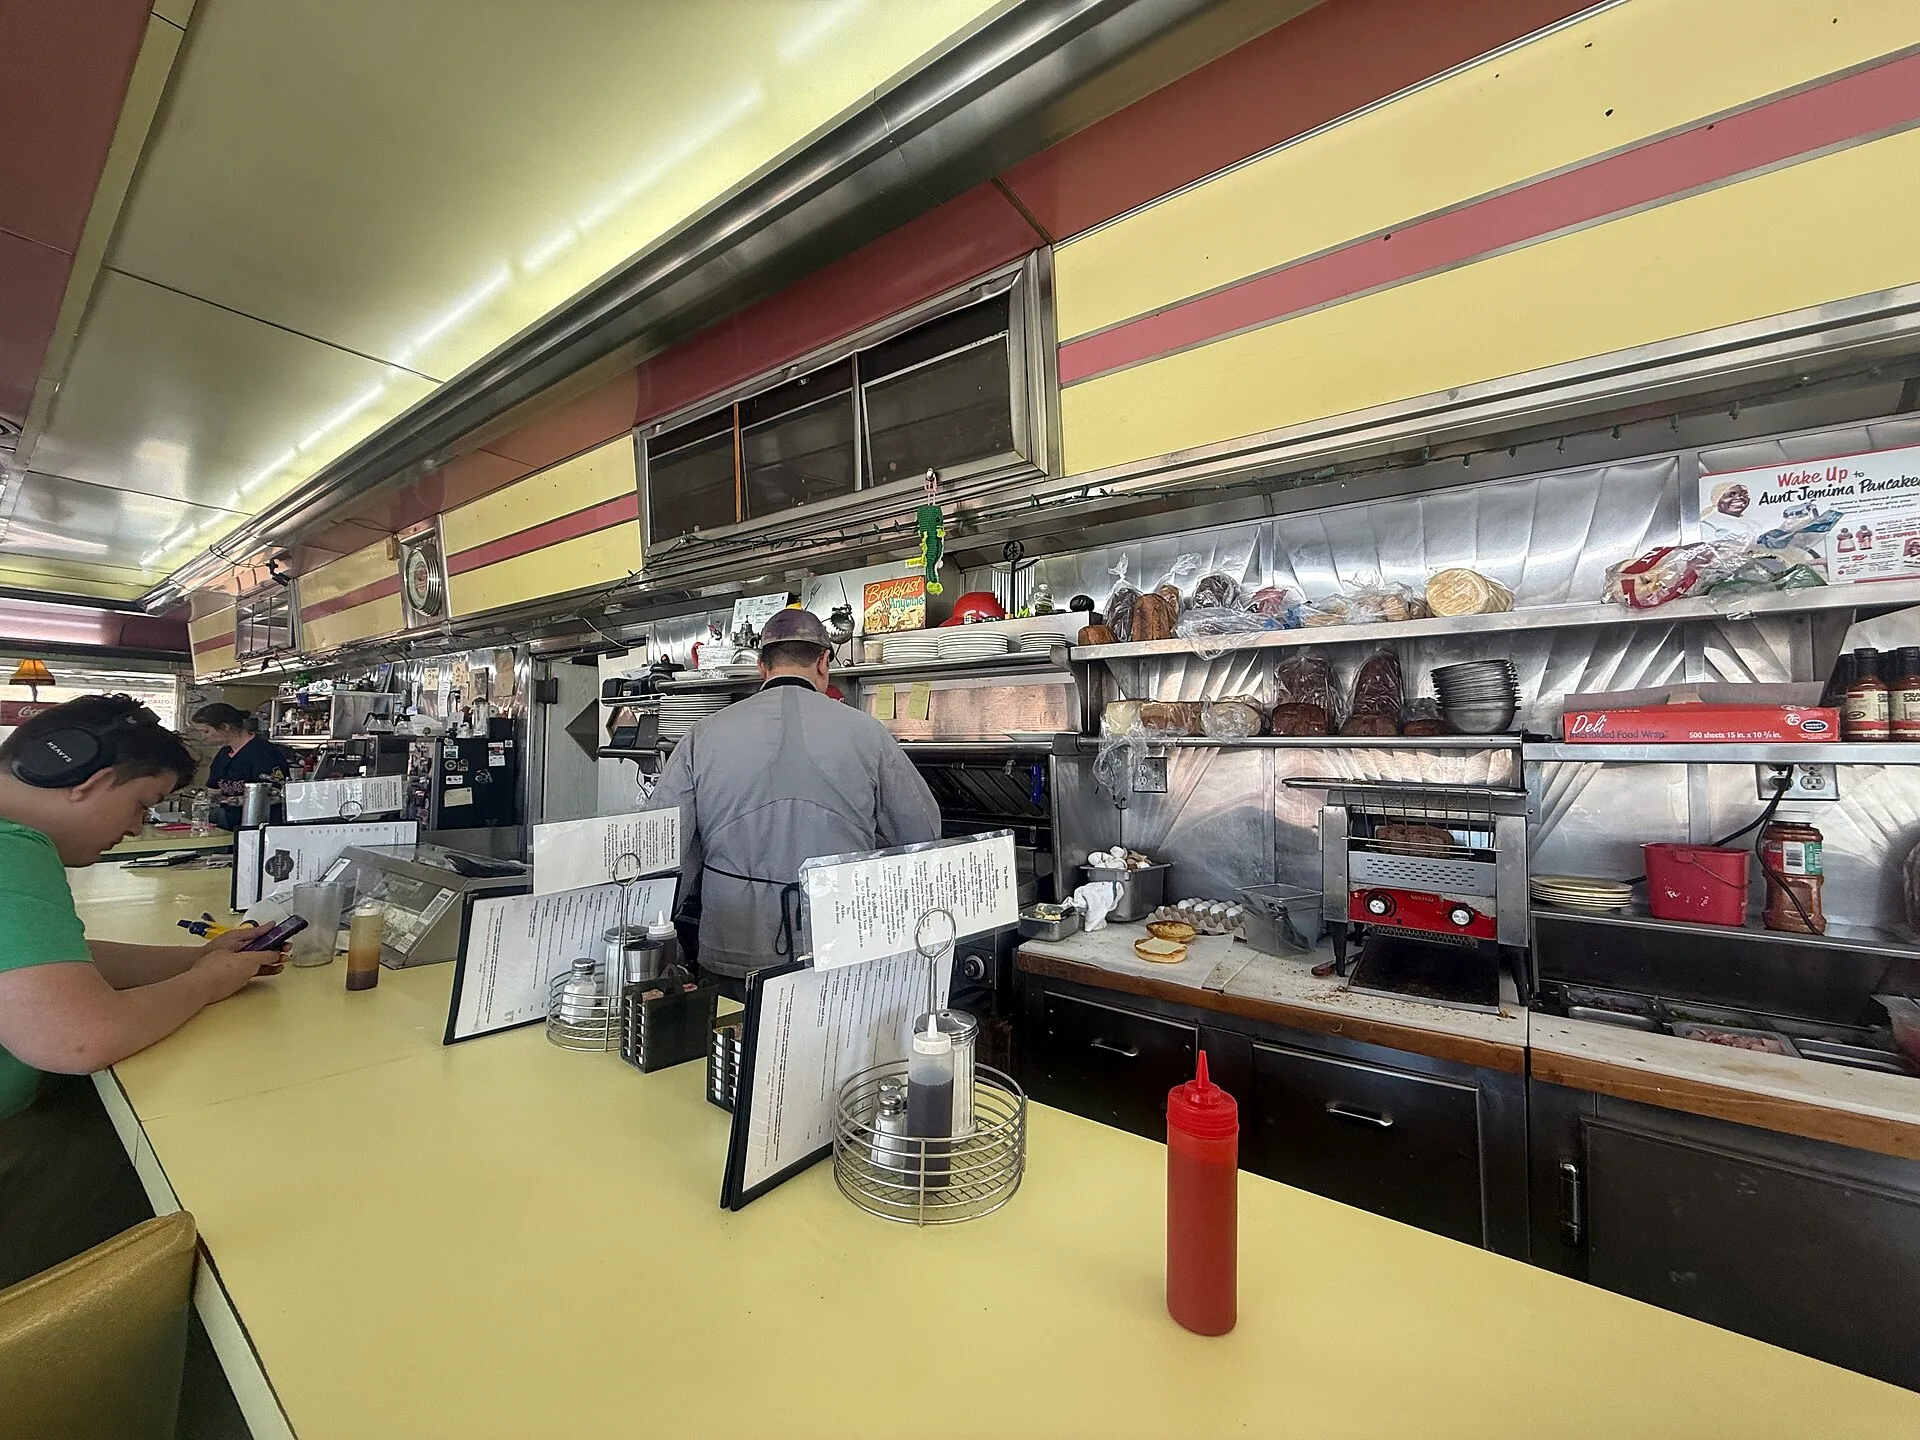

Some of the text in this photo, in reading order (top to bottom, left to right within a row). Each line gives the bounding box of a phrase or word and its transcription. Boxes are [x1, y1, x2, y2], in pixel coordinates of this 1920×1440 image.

[1777, 471, 1822, 487] Wake
[1826, 466, 1849, 484] Up
[1758, 490, 1798, 505] Aunt
[1797, 483, 1855, 500] Jemima
[866, 576, 922, 603] Breakfast
[1571, 714, 1607, 734] Deli
[1617, 730, 1639, 739] Food
[1641, 731, 1665, 741] Wrap
